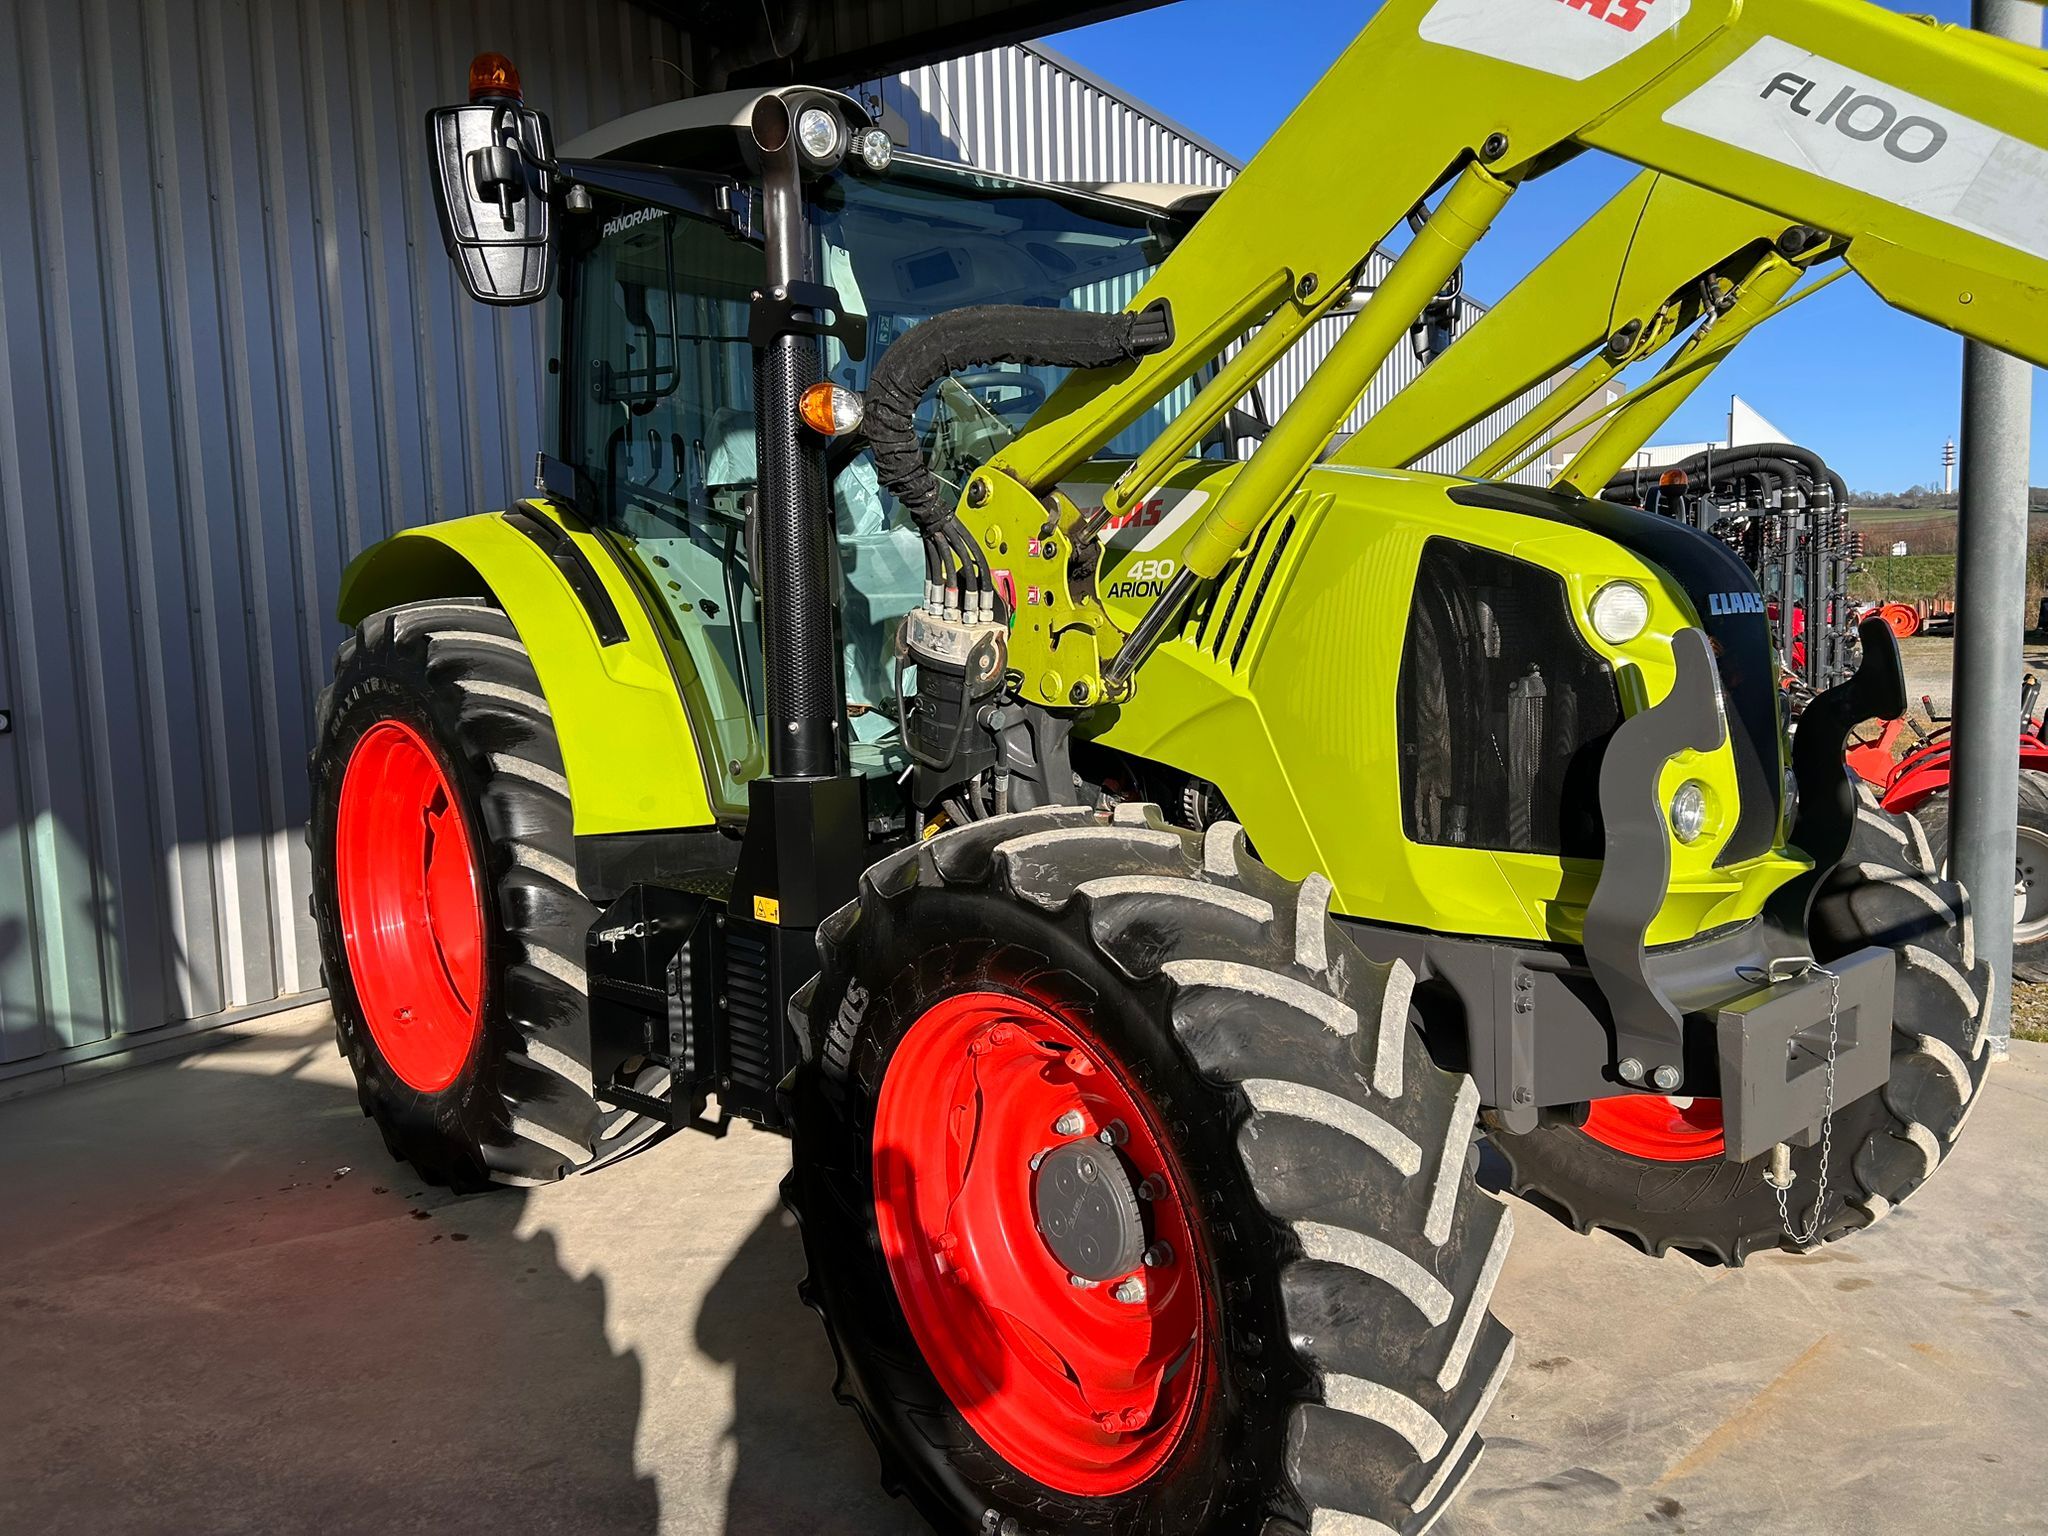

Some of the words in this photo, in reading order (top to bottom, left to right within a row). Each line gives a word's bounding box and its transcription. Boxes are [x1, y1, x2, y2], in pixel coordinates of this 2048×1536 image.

[1759, 71, 1948, 164] FL100
[602, 207, 670, 238] PANORAM
[1126, 559, 1176, 581] 430
[1107, 580, 1164, 599] ARION
[1708, 592, 1765, 616] CLAAS
